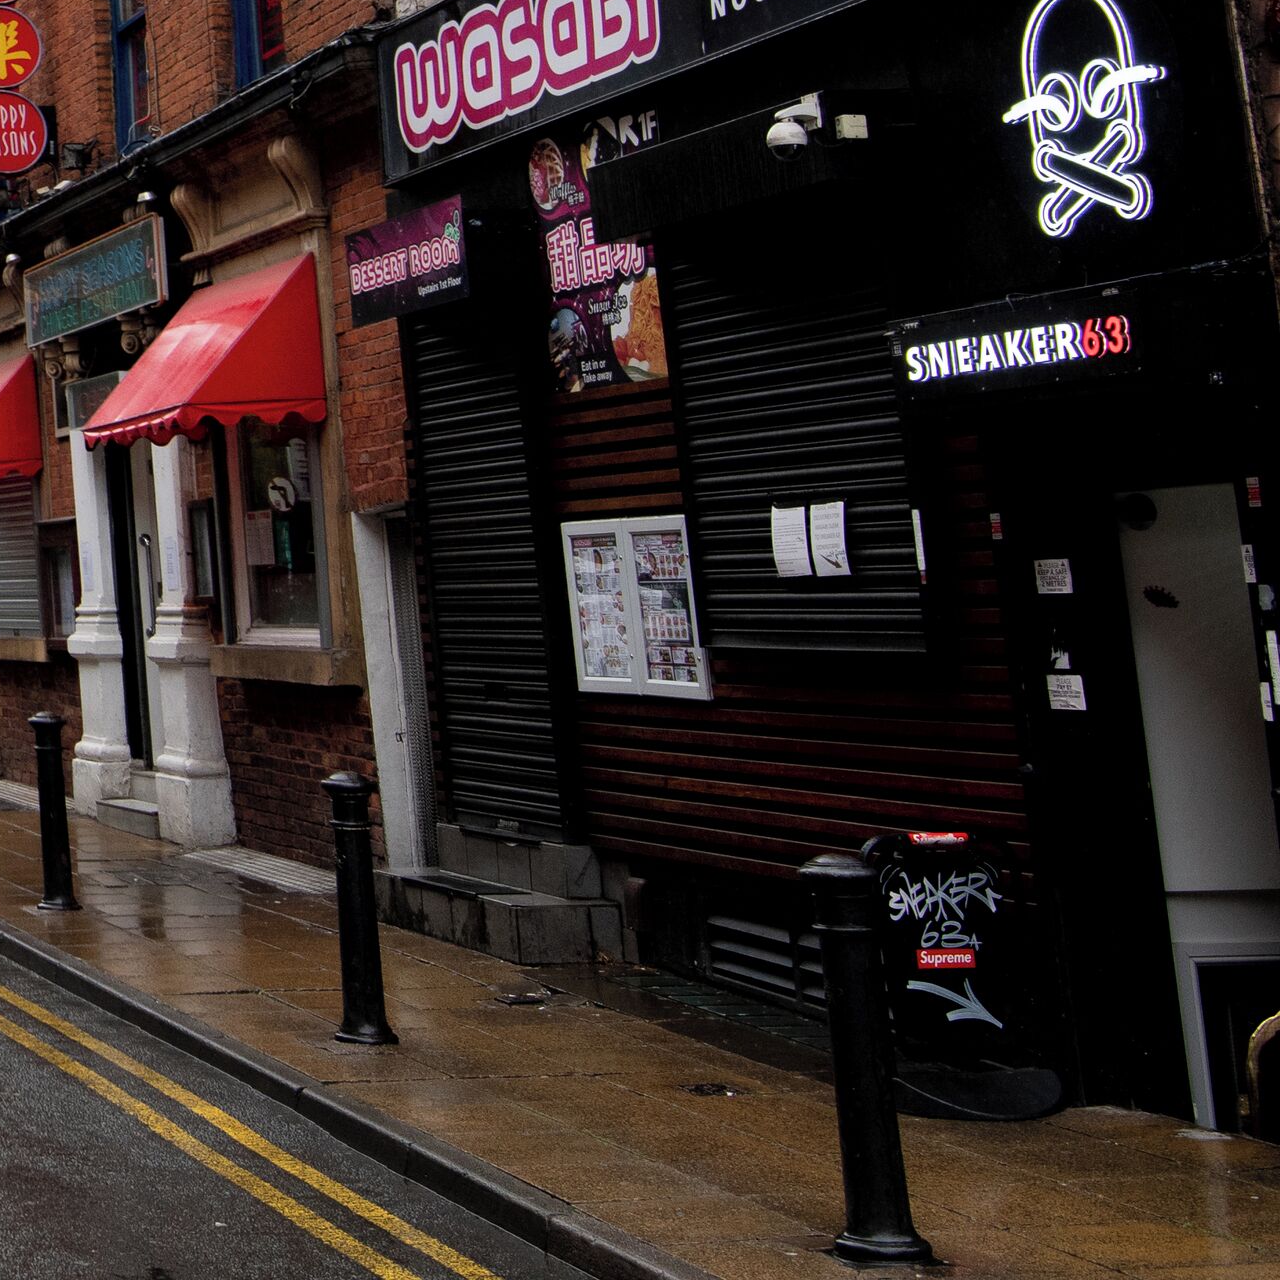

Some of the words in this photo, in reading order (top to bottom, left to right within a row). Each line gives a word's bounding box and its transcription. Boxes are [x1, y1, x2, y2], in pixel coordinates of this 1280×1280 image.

[349, 248, 408, 295] DESSERT
[409, 233, 461, 277] ROOM
[920, 950, 972, 968] Supreme
